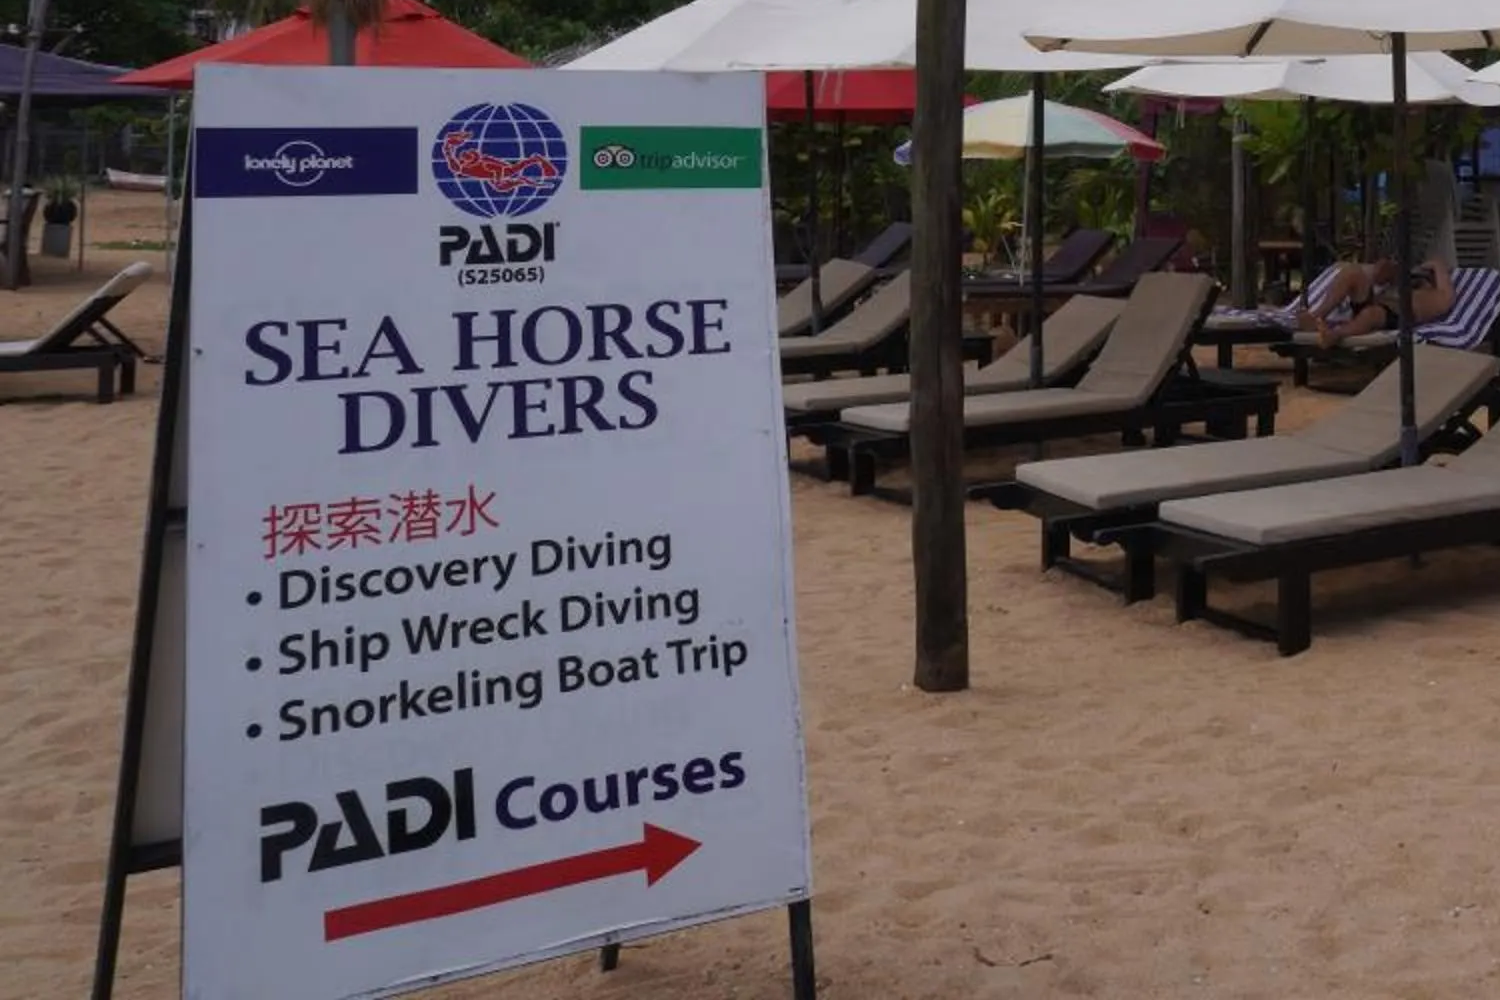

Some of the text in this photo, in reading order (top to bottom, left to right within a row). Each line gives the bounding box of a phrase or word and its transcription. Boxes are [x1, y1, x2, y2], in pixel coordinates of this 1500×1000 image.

[244, 154, 354, 174] lonely planet
[640, 151, 739, 172] tripadvisor
[440, 221, 556, 266] PADI
[457, 266, 545, 288] (S25065)
[245, 298, 731, 386] SEA HORSE
[337, 369, 658, 455] DIVERS
[262, 484, 499, 562] 探索潜水
[279, 531, 672, 610] Discovery Diving
[278, 586, 699, 681] Ship Wreck Diving
[279, 634, 748, 742] Snorkeling Boat Trip
[259, 751, 746, 884] PADI Courses
